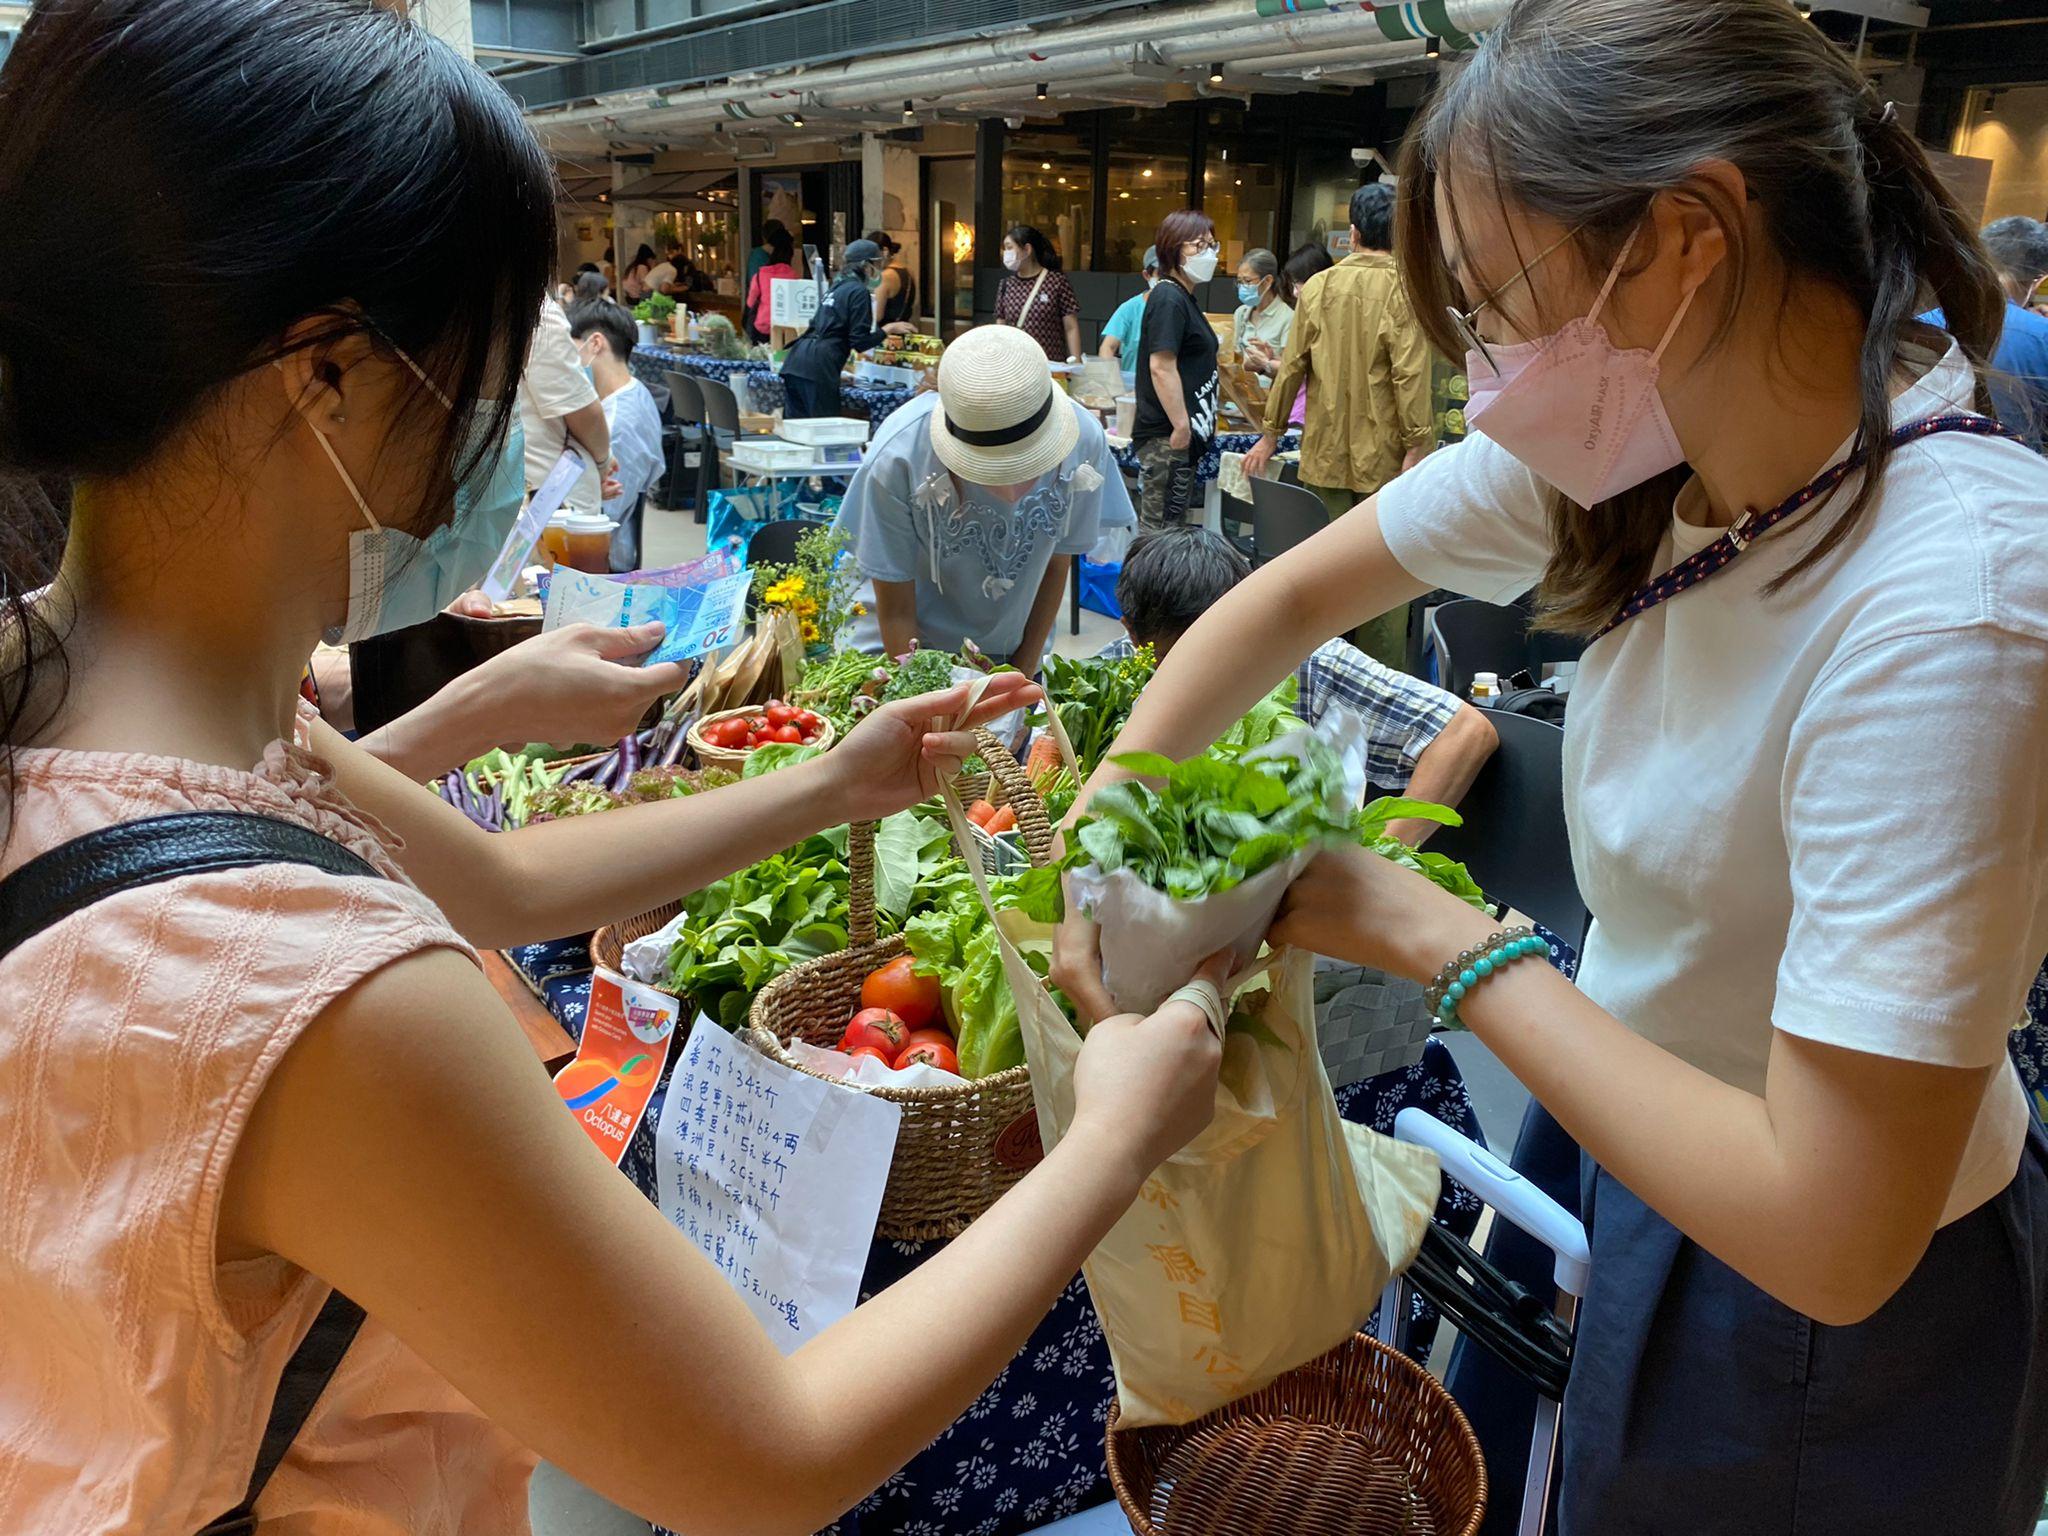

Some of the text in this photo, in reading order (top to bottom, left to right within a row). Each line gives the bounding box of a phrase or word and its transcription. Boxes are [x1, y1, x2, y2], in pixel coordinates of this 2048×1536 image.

[1583, 404, 1604, 451] OxyAIR
[702, 624, 732, 649] 20
[584, 1108, 625, 1141] Octopus
